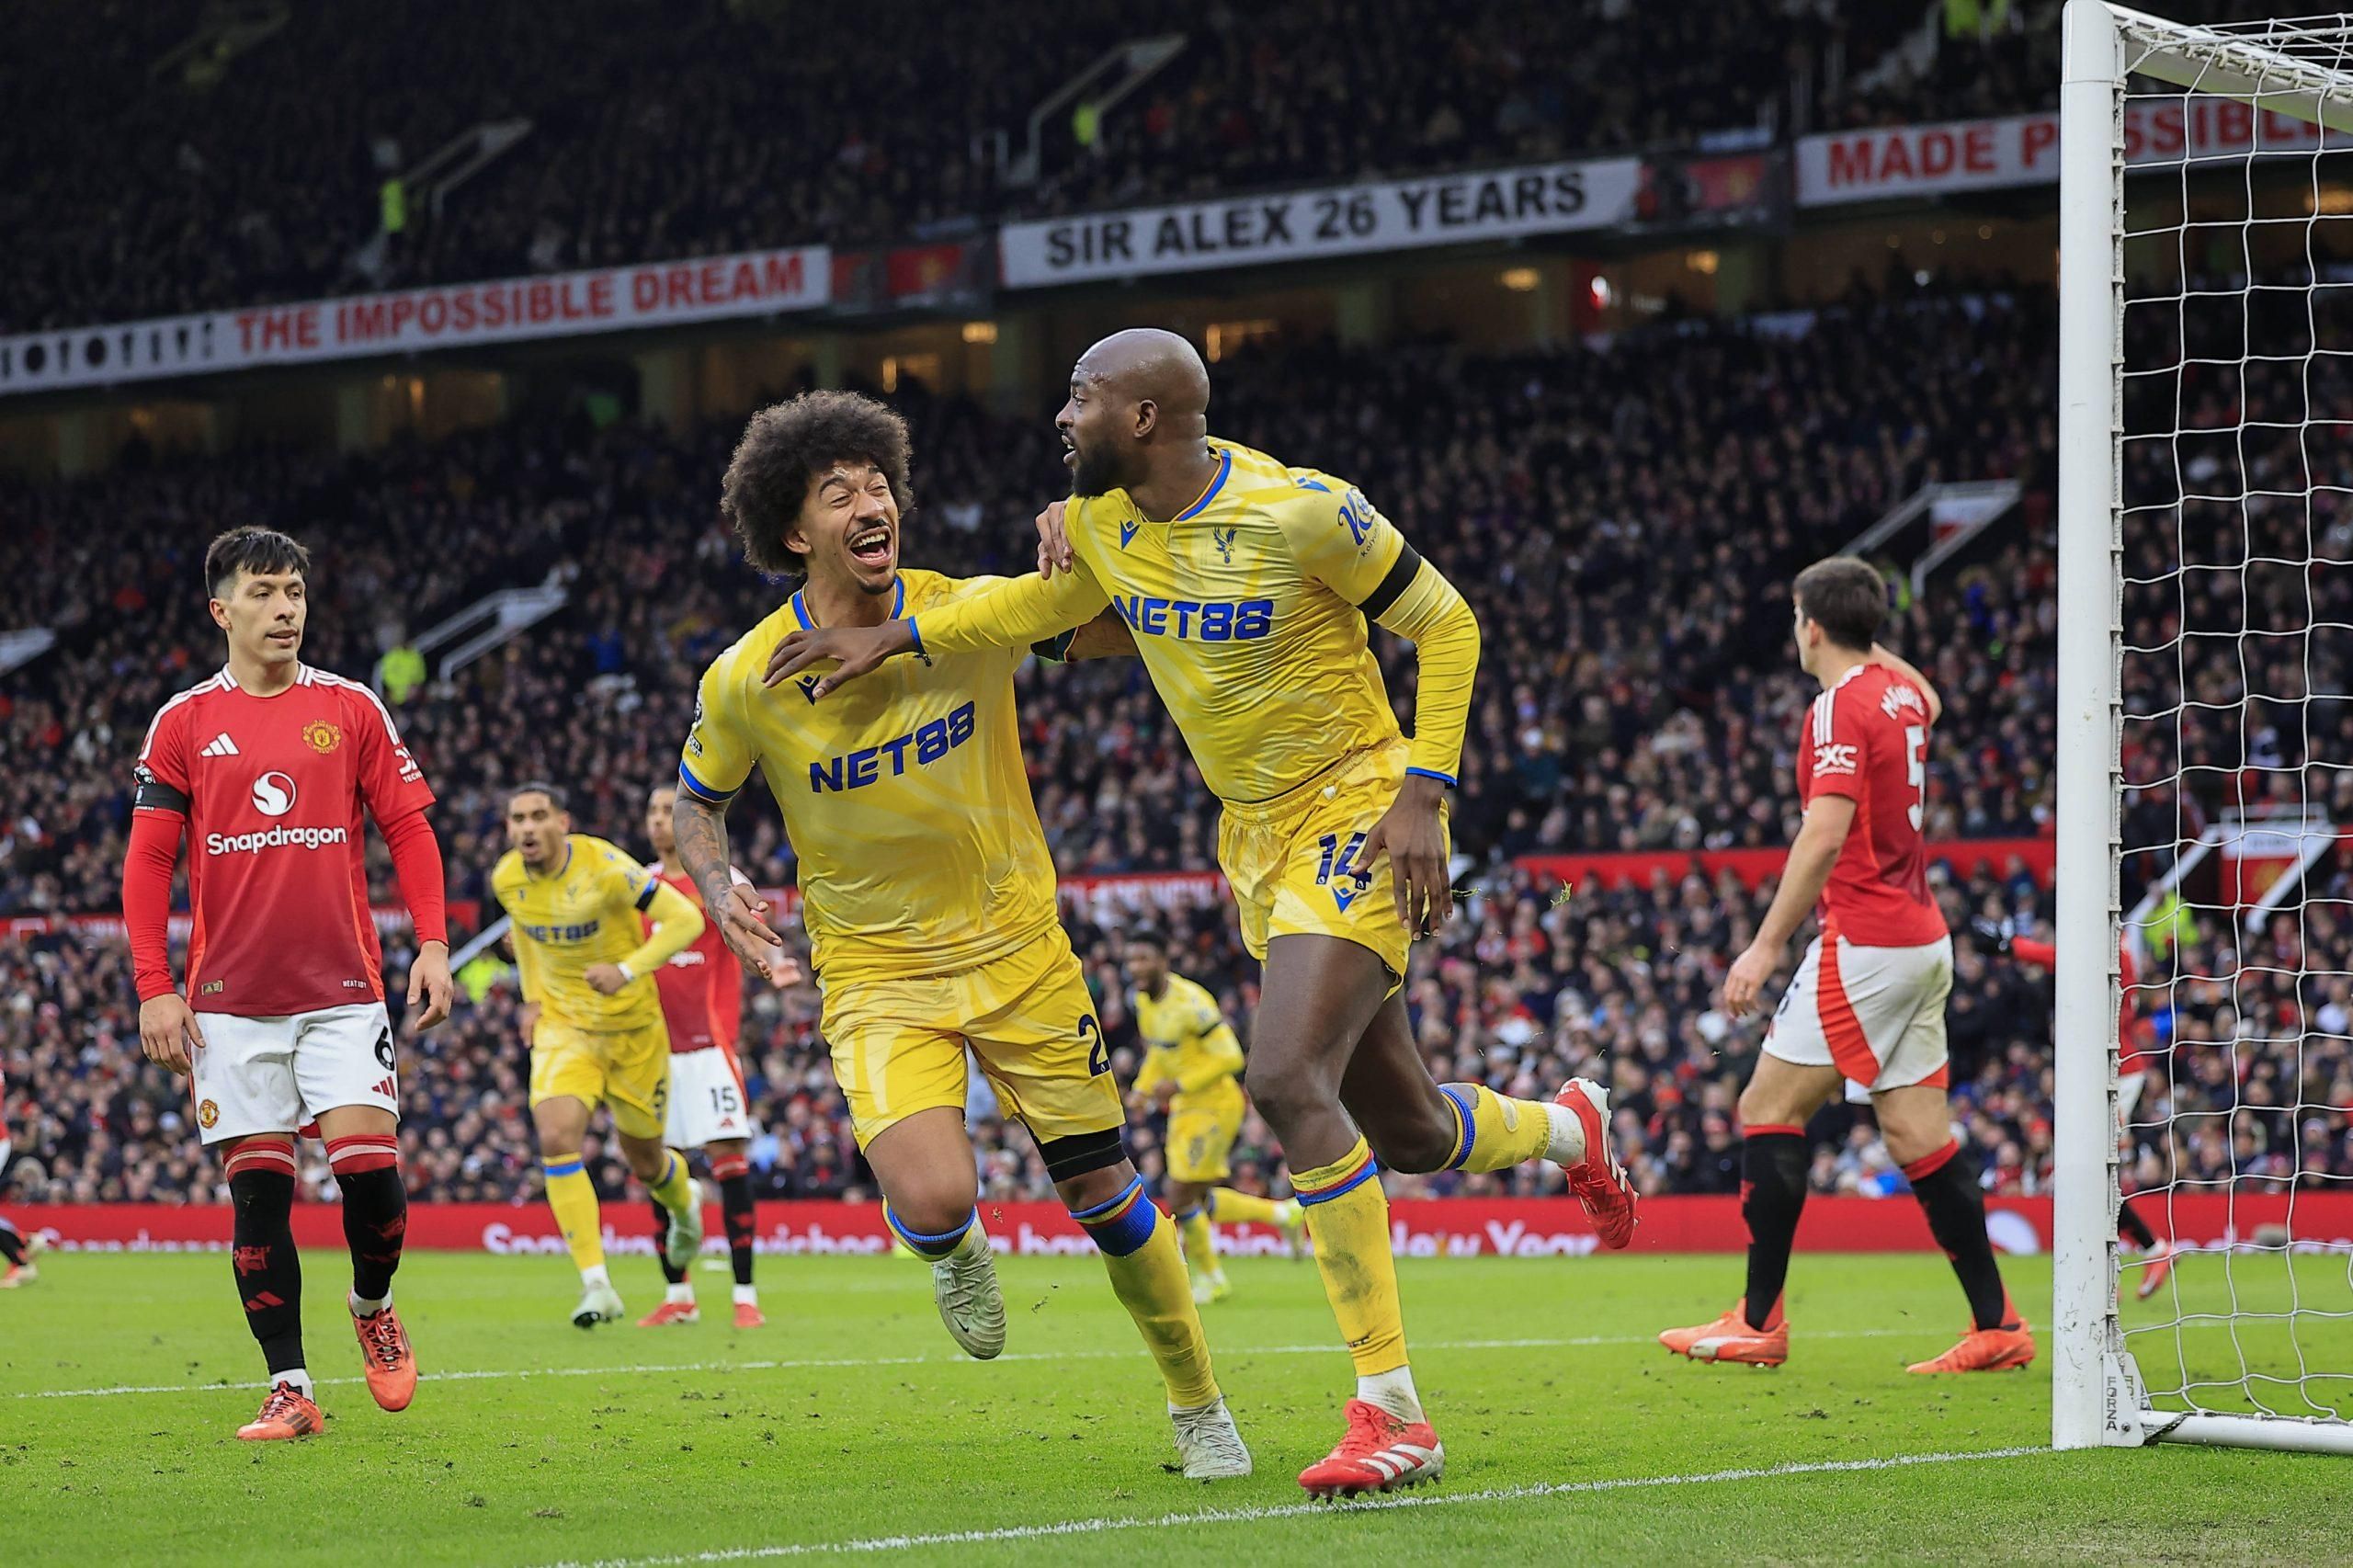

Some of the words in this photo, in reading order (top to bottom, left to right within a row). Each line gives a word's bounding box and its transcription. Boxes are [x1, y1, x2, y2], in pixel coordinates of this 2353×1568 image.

[1828, 124, 1996, 184] MADE
[2022, 100, 2335, 166] PSSIBL
[1046, 221, 1135, 268] SIR
[1154, 205, 1294, 257] ALEX
[1313, 194, 1377, 240] 26
[1399, 171, 1587, 231] YEARS
[235, 306, 319, 355] THE
[335, 276, 615, 344] IMPOSSIBLE
[631, 254, 804, 314] DREAM
[1114, 594, 1274, 642] NET88
[809, 700, 975, 794] NET88
[205, 824, 348, 856] Snapdragon
[1315, 832, 1373, 892] 14
[374, 1025, 395, 1073] 6
[710, 1086, 738, 1113] 15
